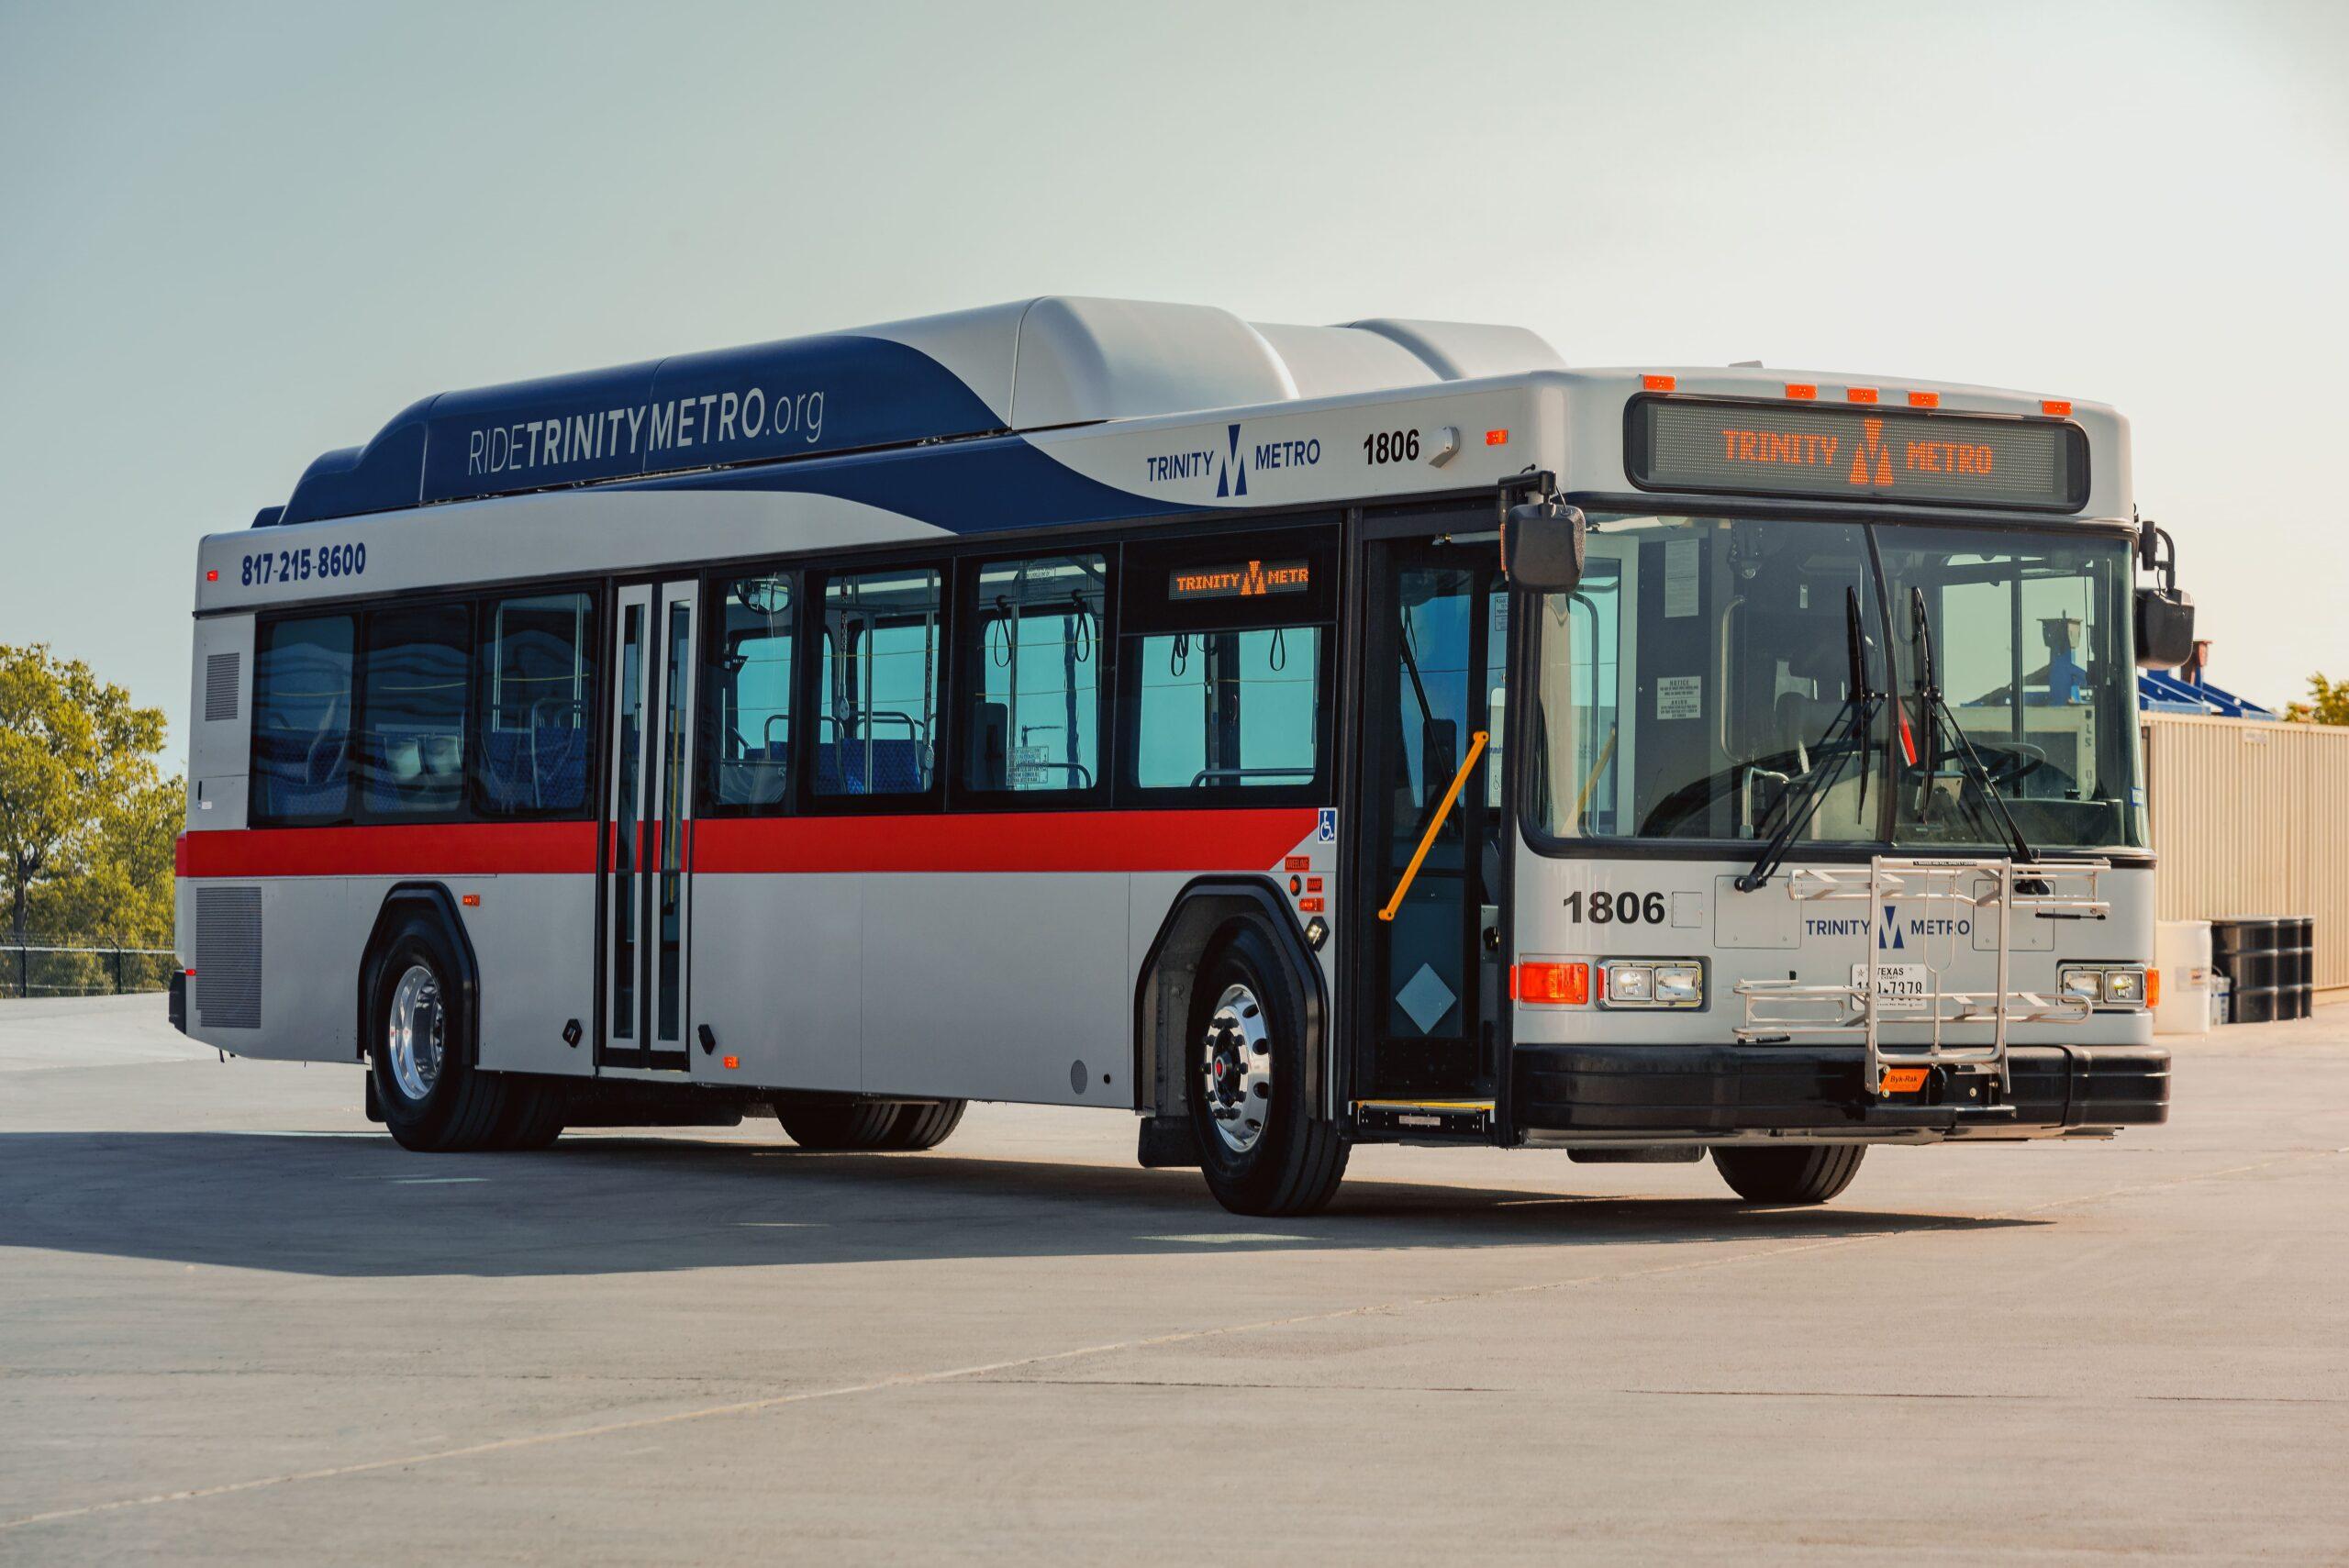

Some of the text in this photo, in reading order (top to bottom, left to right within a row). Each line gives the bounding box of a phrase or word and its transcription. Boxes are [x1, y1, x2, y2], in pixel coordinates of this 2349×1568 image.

[468, 387, 825, 477] RIDETRINITYMETRO.org
[1363, 428, 1420, 466] 1806
[1723, 428, 1993, 474] TRINITY METRO
[1147, 438, 1321, 483] TRINITY METRO
[241, 542, 367, 587] 817-215-8600
[1175, 568, 1309, 593] TRINITY METR
[1564, 891, 1665, 925] 1806
[1806, 919, 1970, 936] TRINITY METRO
[1877, 967, 1904, 976] TEXAS
